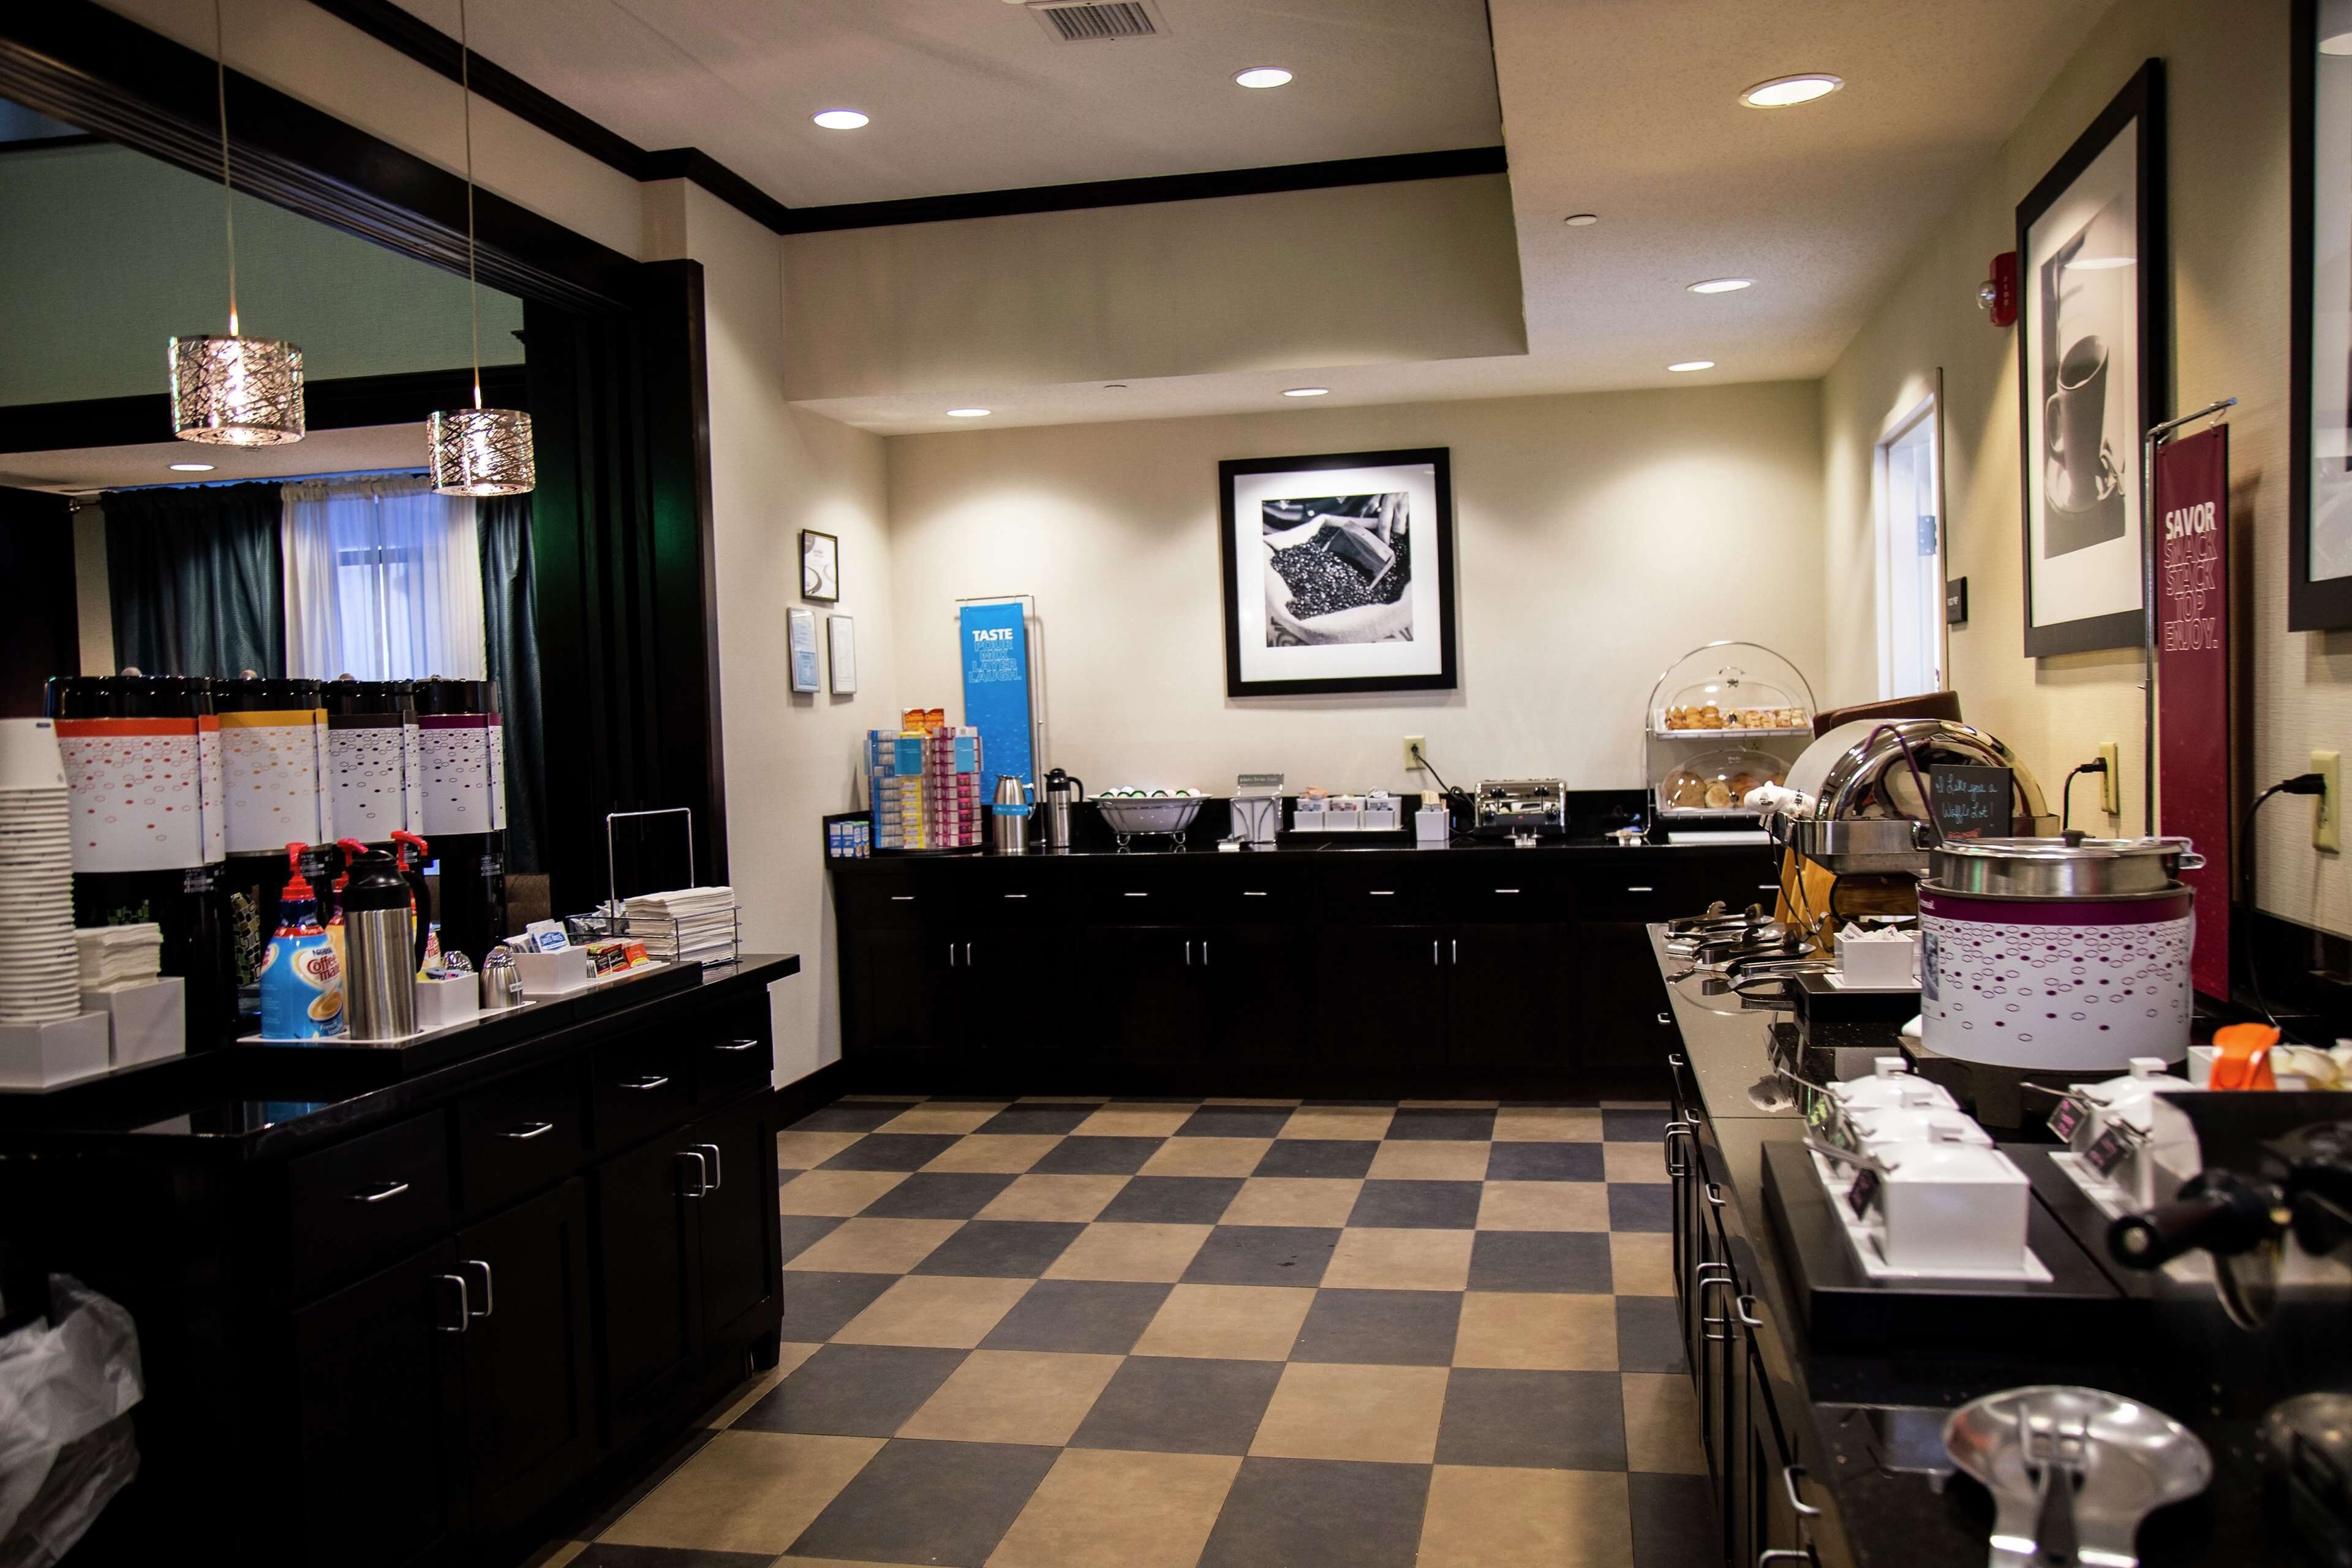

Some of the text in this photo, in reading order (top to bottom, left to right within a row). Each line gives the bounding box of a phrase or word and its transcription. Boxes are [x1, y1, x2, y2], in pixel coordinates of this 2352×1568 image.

[2165, 501, 2217, 540] SAVOR
[2166, 559, 2216, 596] STACK
[2174, 589, 2205, 622] TOP
[972, 628, 1013, 642] TASTE
[2164, 616, 2218, 652] ENJOY.
[974, 639, 1014, 652] POUR
[979, 648, 1009, 662] MIX
[972, 658, 1018, 673] LAYER
[968, 668, 1022, 683] LAUGH.
[307, 956, 336, 974] Coffee
